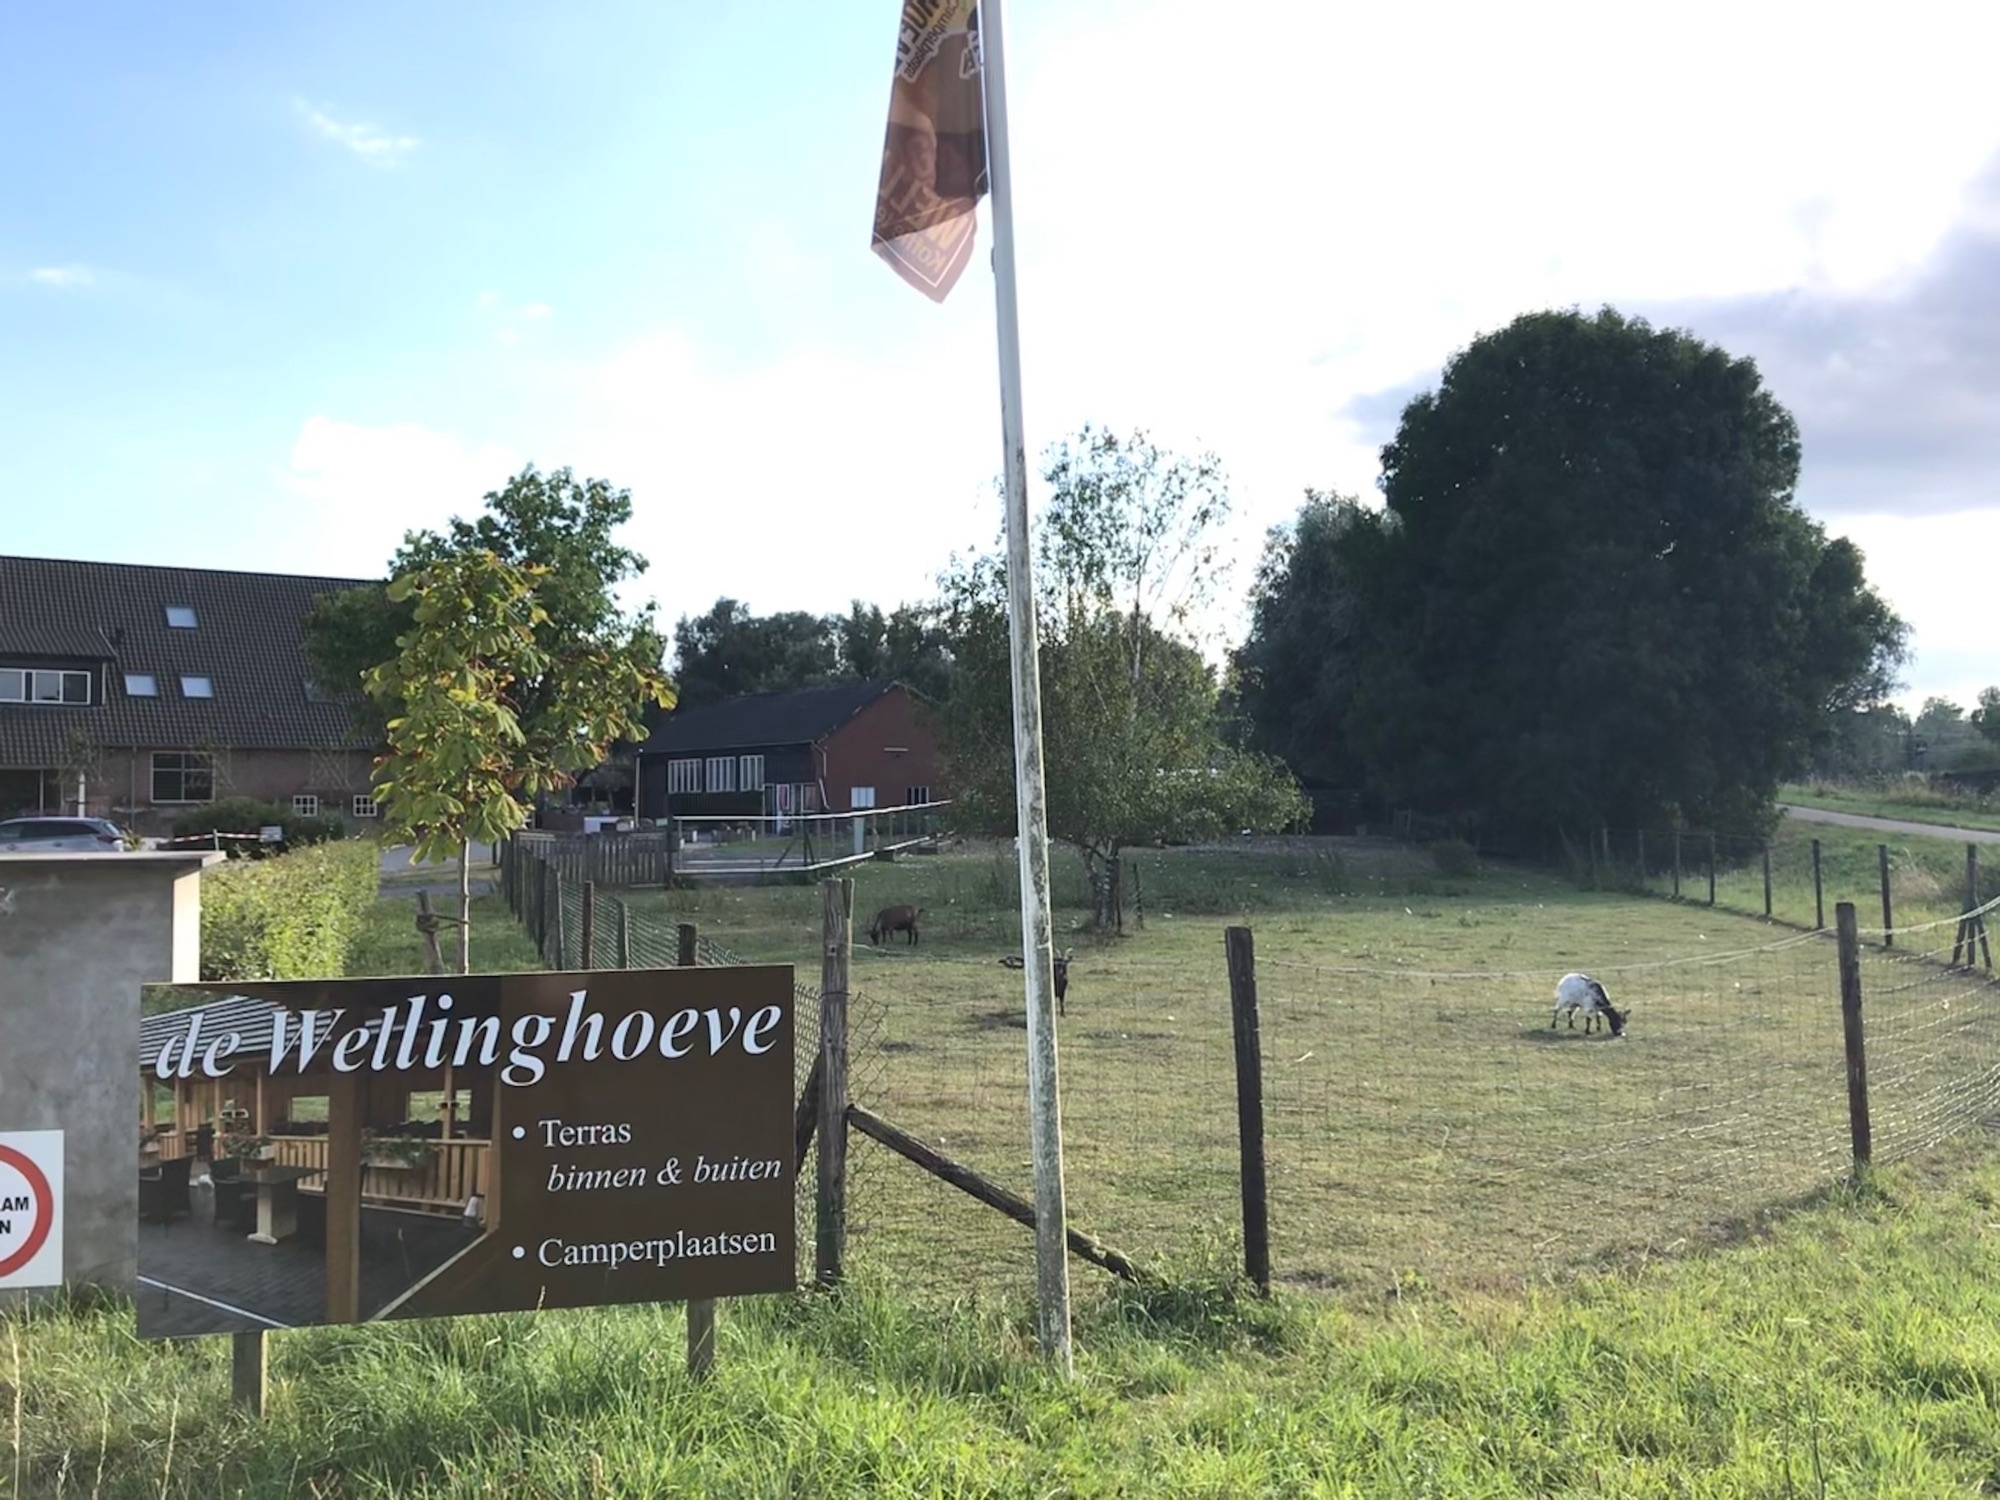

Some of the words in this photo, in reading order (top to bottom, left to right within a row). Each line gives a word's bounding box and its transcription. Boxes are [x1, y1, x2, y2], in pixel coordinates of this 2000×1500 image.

[156, 1012, 242, 1079] de
[268, 989, 782, 1087] Wellinghoeve
[538, 1119, 632, 1148] Terras
[547, 1164, 647, 1192] binnen
[656, 1156, 683, 1186] &
[693, 1155, 782, 1184] buiten
[0, 1196, 29, 1211] AM
[538, 1229, 776, 1270] Camperplaatsen
